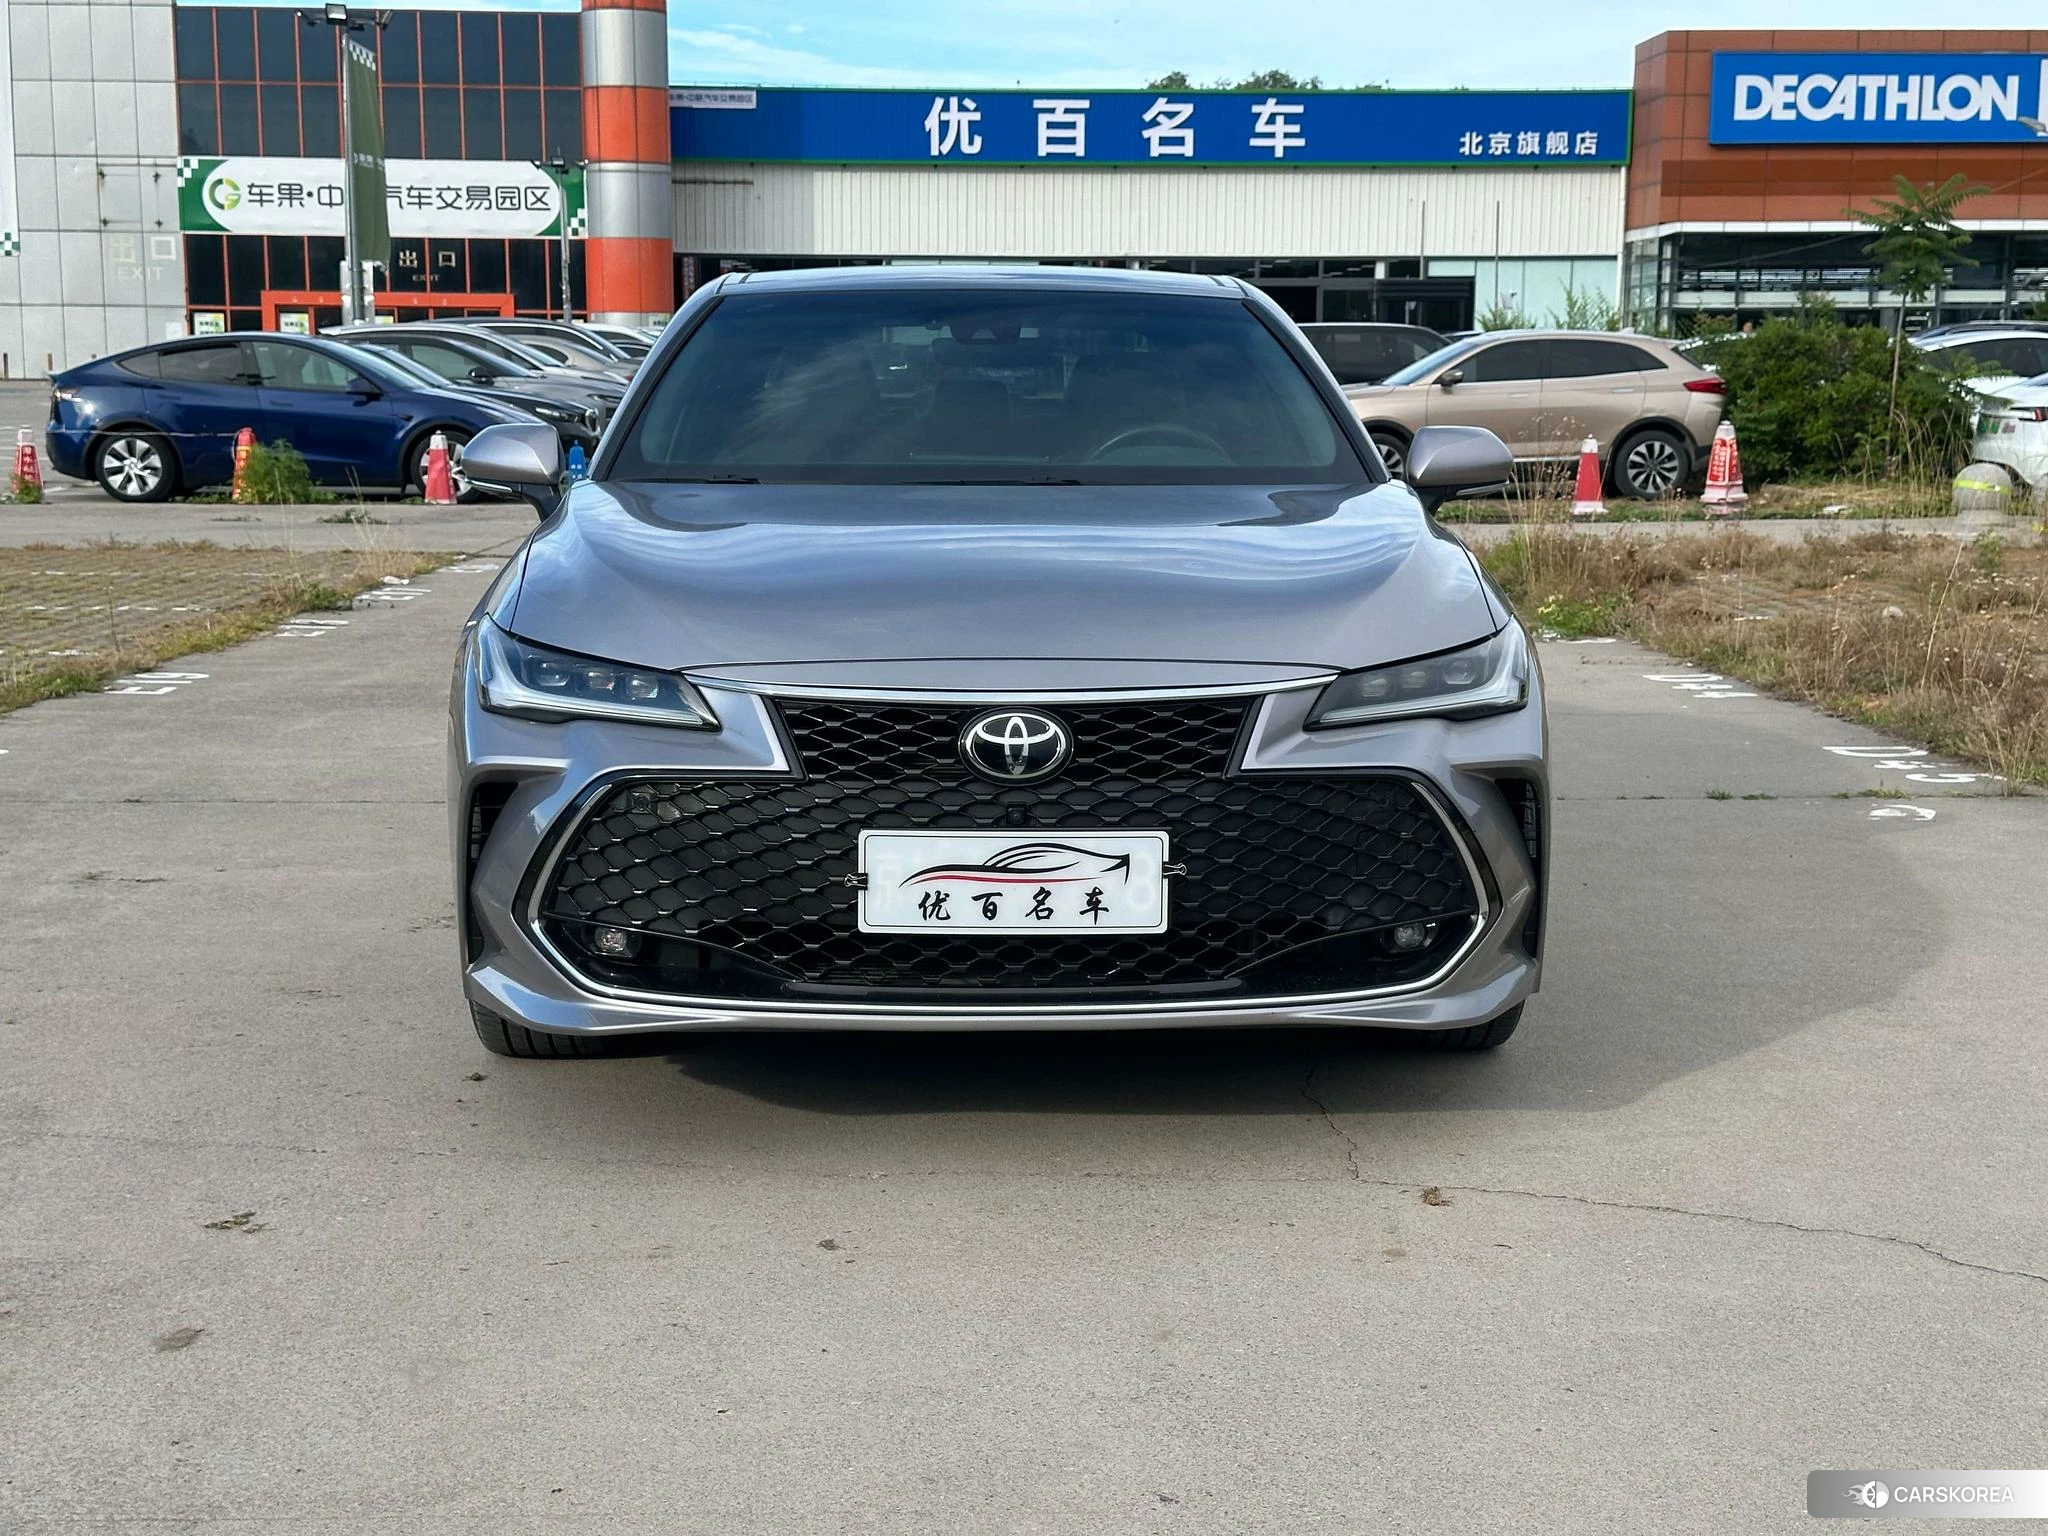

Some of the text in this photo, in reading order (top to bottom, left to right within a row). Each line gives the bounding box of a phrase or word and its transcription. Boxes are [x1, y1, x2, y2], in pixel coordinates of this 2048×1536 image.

[1733, 74, 2019, 121] DECATHLON
[924, 97, 1306, 158] 优百名车
[1459, 131, 1598, 156] 北京旗舰店
[247, 182, 551, 211] 车果·中汽车交易园区
[399, 250, 456, 267] 出口
[917, 886, 1110, 925] 优百名车
